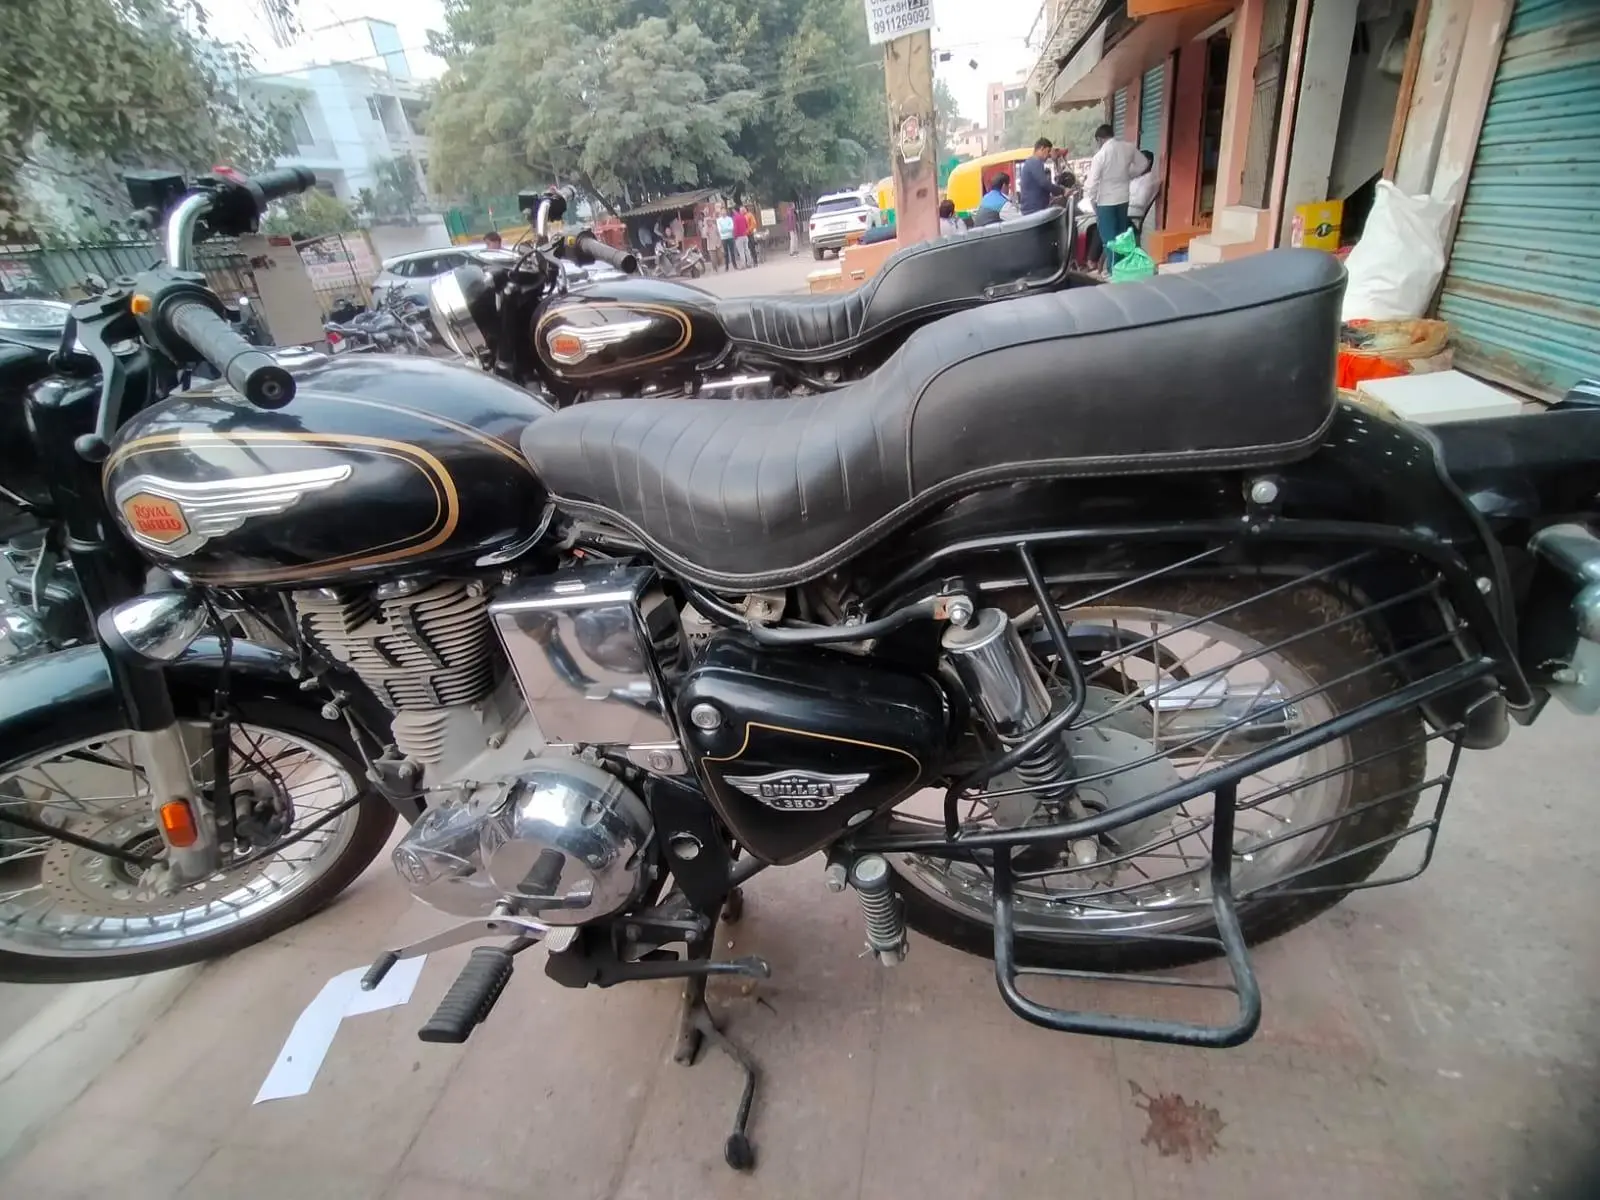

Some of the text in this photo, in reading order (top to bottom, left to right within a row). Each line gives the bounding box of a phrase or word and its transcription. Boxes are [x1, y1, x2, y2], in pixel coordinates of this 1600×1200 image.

[872, 1, 908, 18] TO CASH
[873, 7, 930, 35] 9911269092
[133, 504, 172, 519] ROYAL
[762, 783, 831, 797] BULLET
[784, 799, 815, 808] 350
